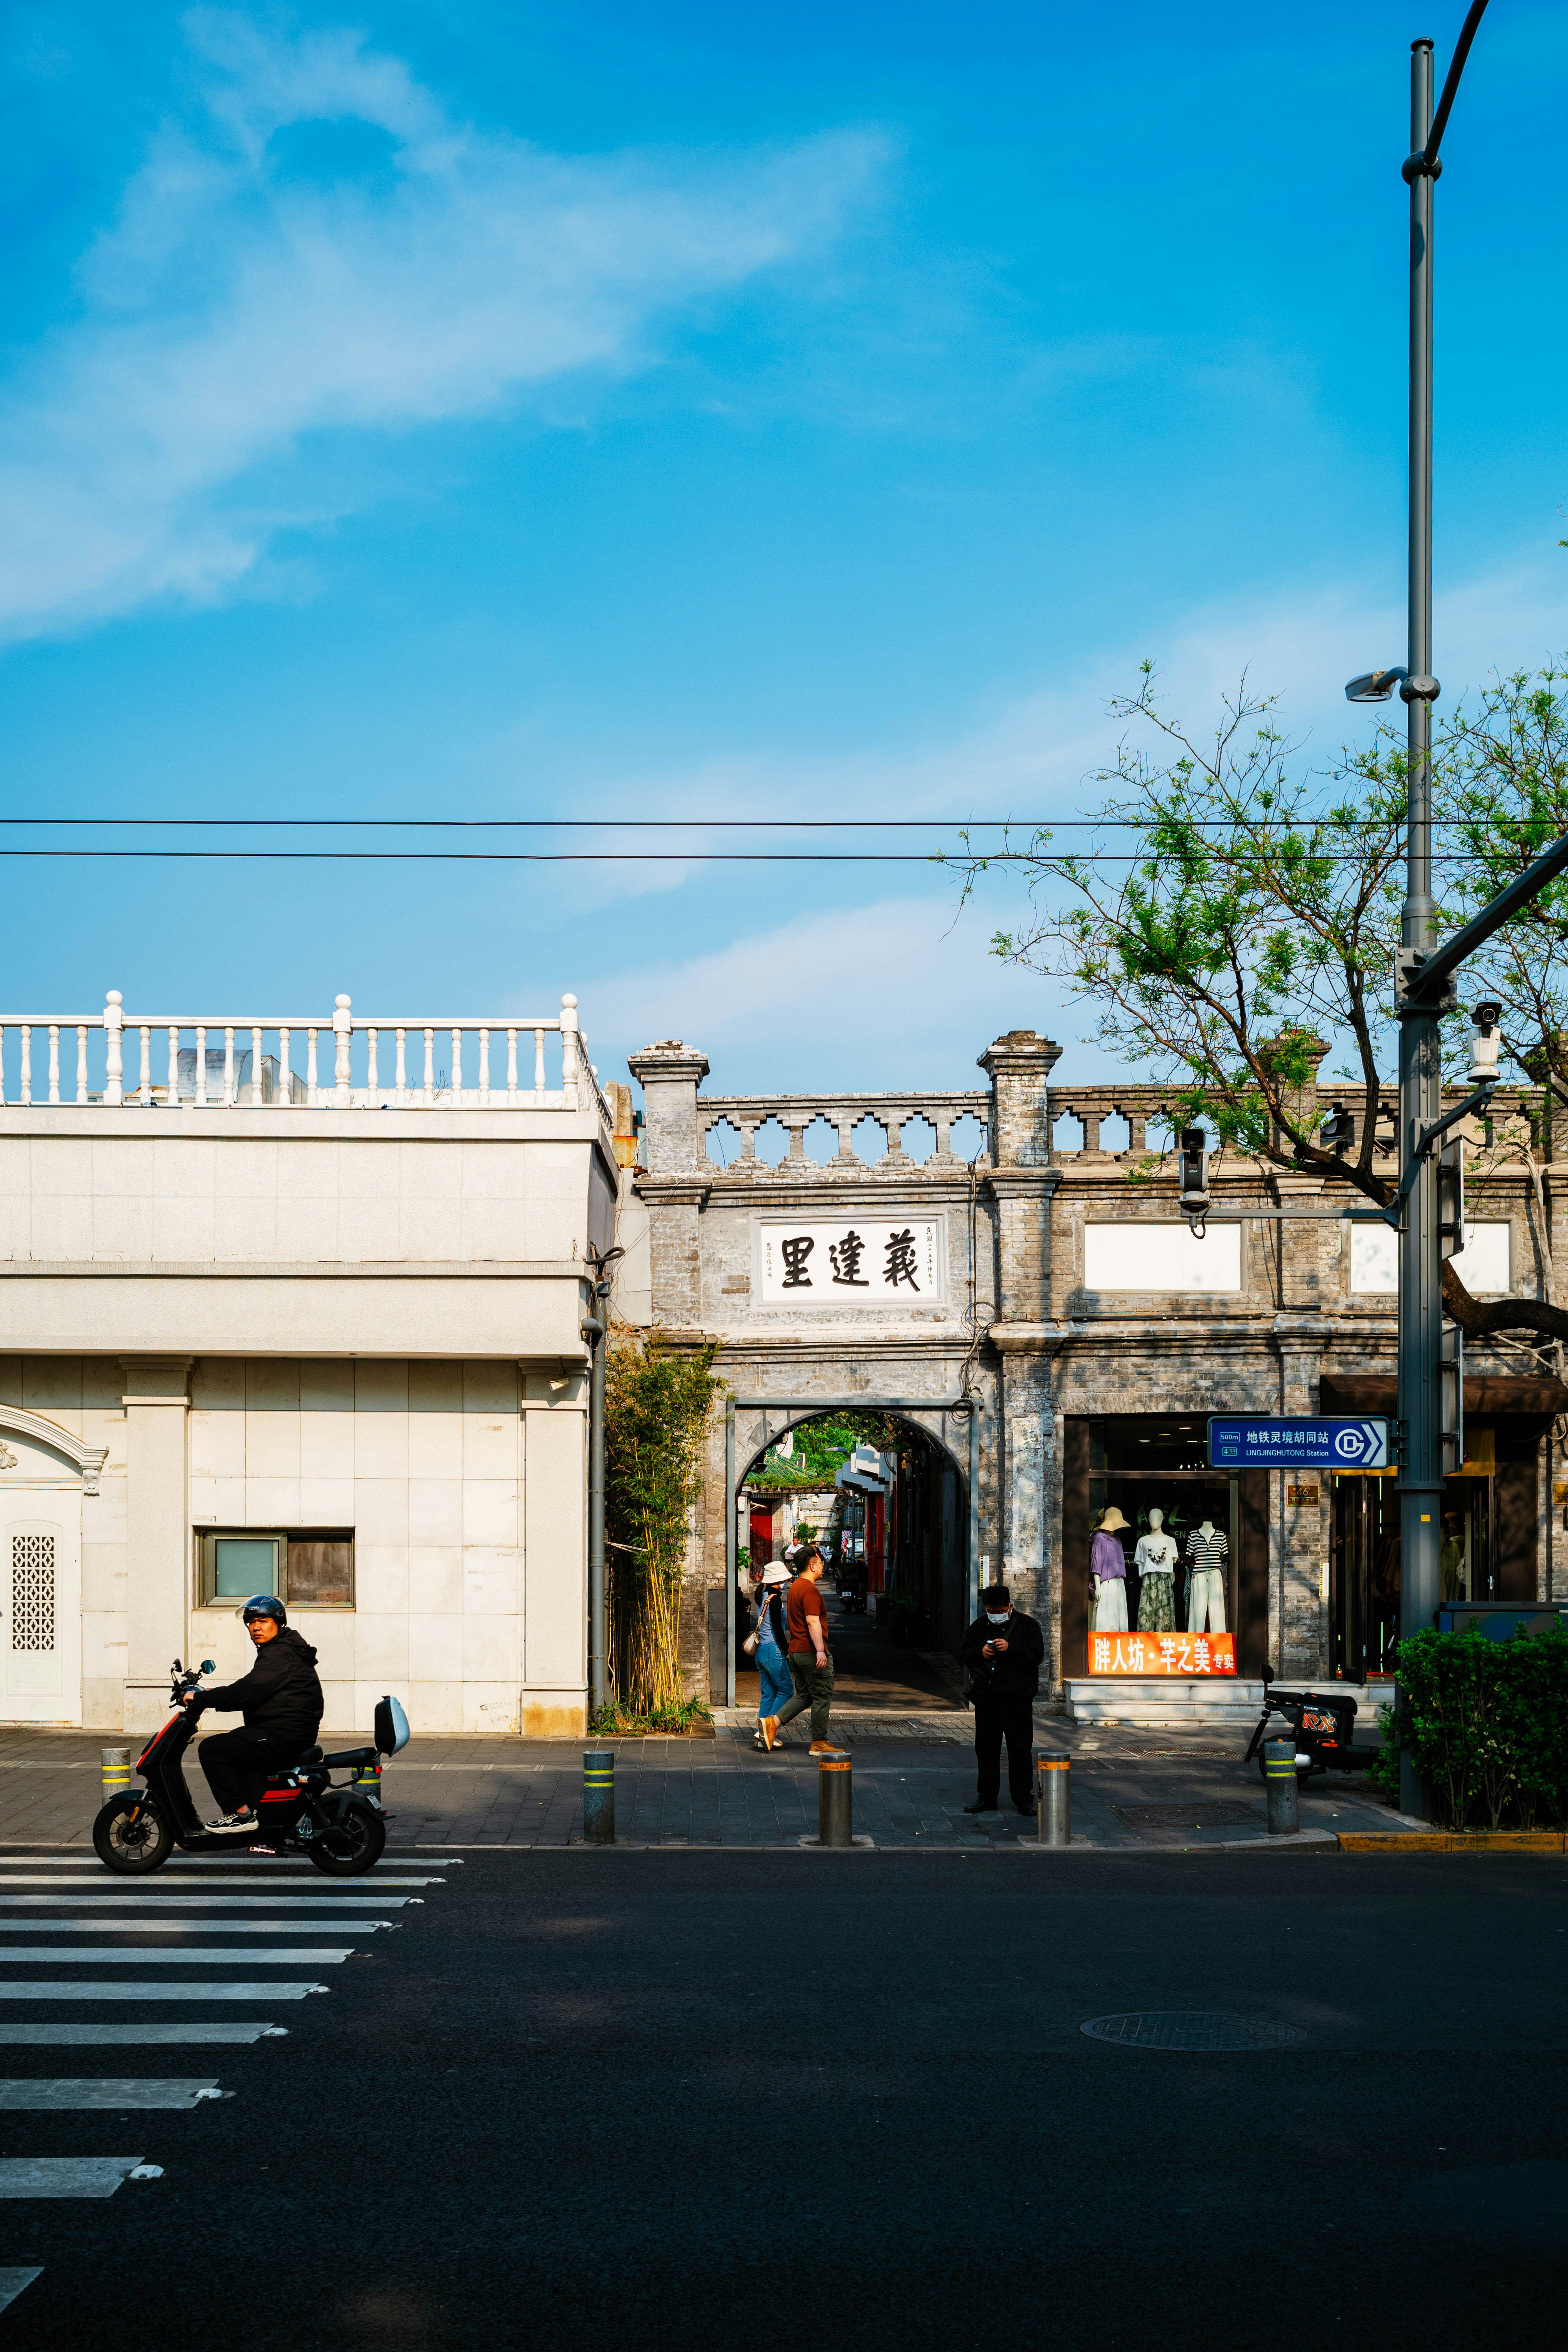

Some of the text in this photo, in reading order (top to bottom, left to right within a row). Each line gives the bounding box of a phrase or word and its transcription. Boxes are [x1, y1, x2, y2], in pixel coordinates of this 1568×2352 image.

[1246, 1431, 1329, 1444] 地铁灵境胡同站
[1297, 1487, 1308, 1496] 46
